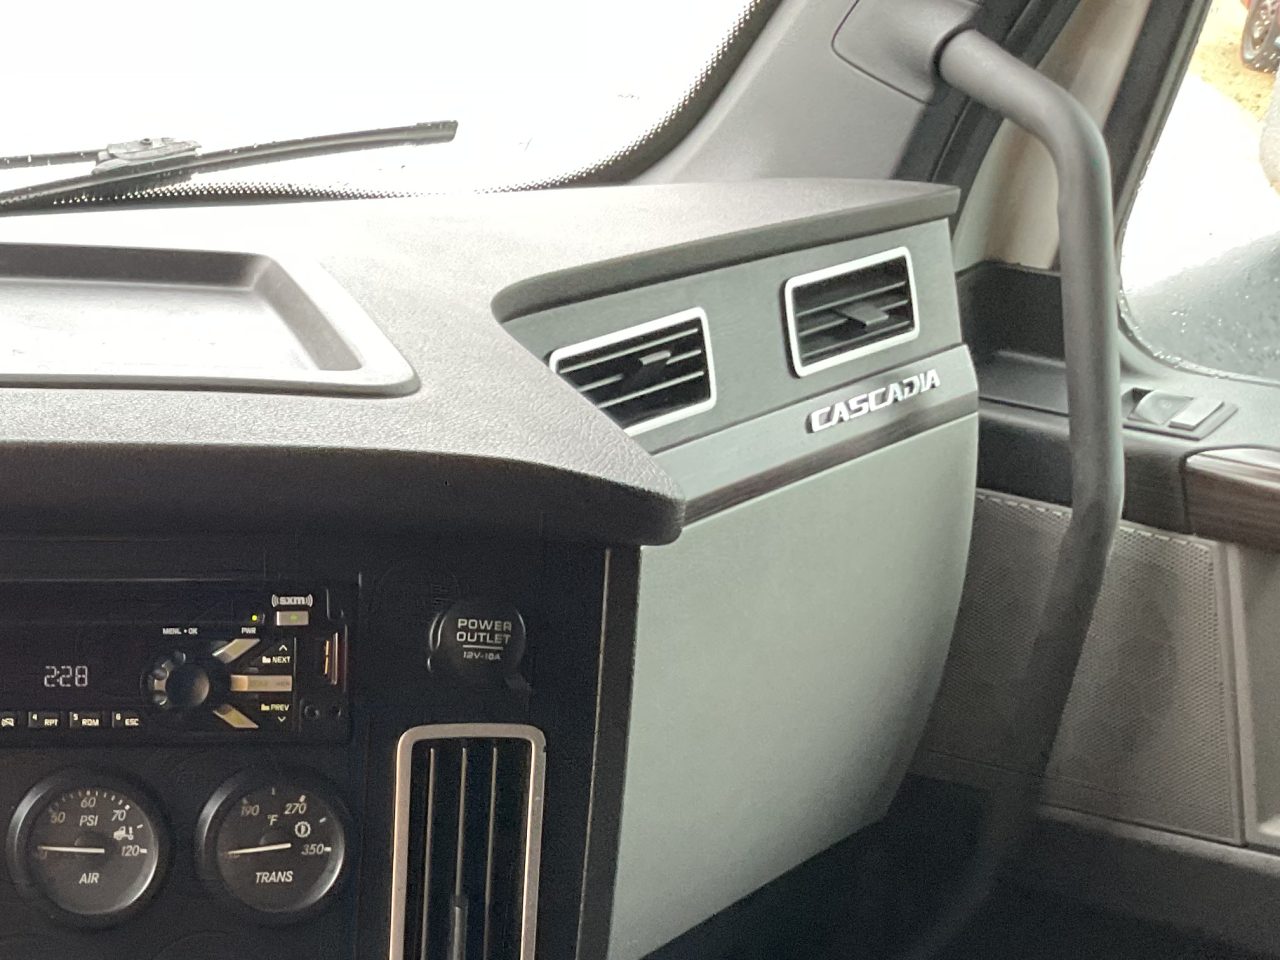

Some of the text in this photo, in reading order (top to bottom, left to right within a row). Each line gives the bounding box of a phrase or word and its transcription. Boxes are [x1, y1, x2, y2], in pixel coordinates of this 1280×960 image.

[810, 369, 941, 433] CASCADIA
[457, 618, 512, 631] POWER
[188, 627, 198, 635] OK
[241, 627, 256, 635] PWR
[456, 631, 511, 644] OUTLET
[272, 655, 291, 664] NEXT
[43, 665, 88, 688] 2:28
[270, 703, 290, 712] PREV
[43, 718, 59, 727] RPT
[81, 718, 100, 727] RDM
[124, 717, 140, 726] ESC
[80, 797, 96, 809] 60
[284, 803, 307, 815] 270
[111, 809, 126, 822] 70
[240, 804, 260, 817] 190
[50, 811, 66, 824] 50
[79, 815, 99, 827] PSI
[121, 844, 140, 857] 120
[301, 843, 325, 856] 350
[79, 872, 100, 884] AIR
[255, 870, 294, 884] TRANS
